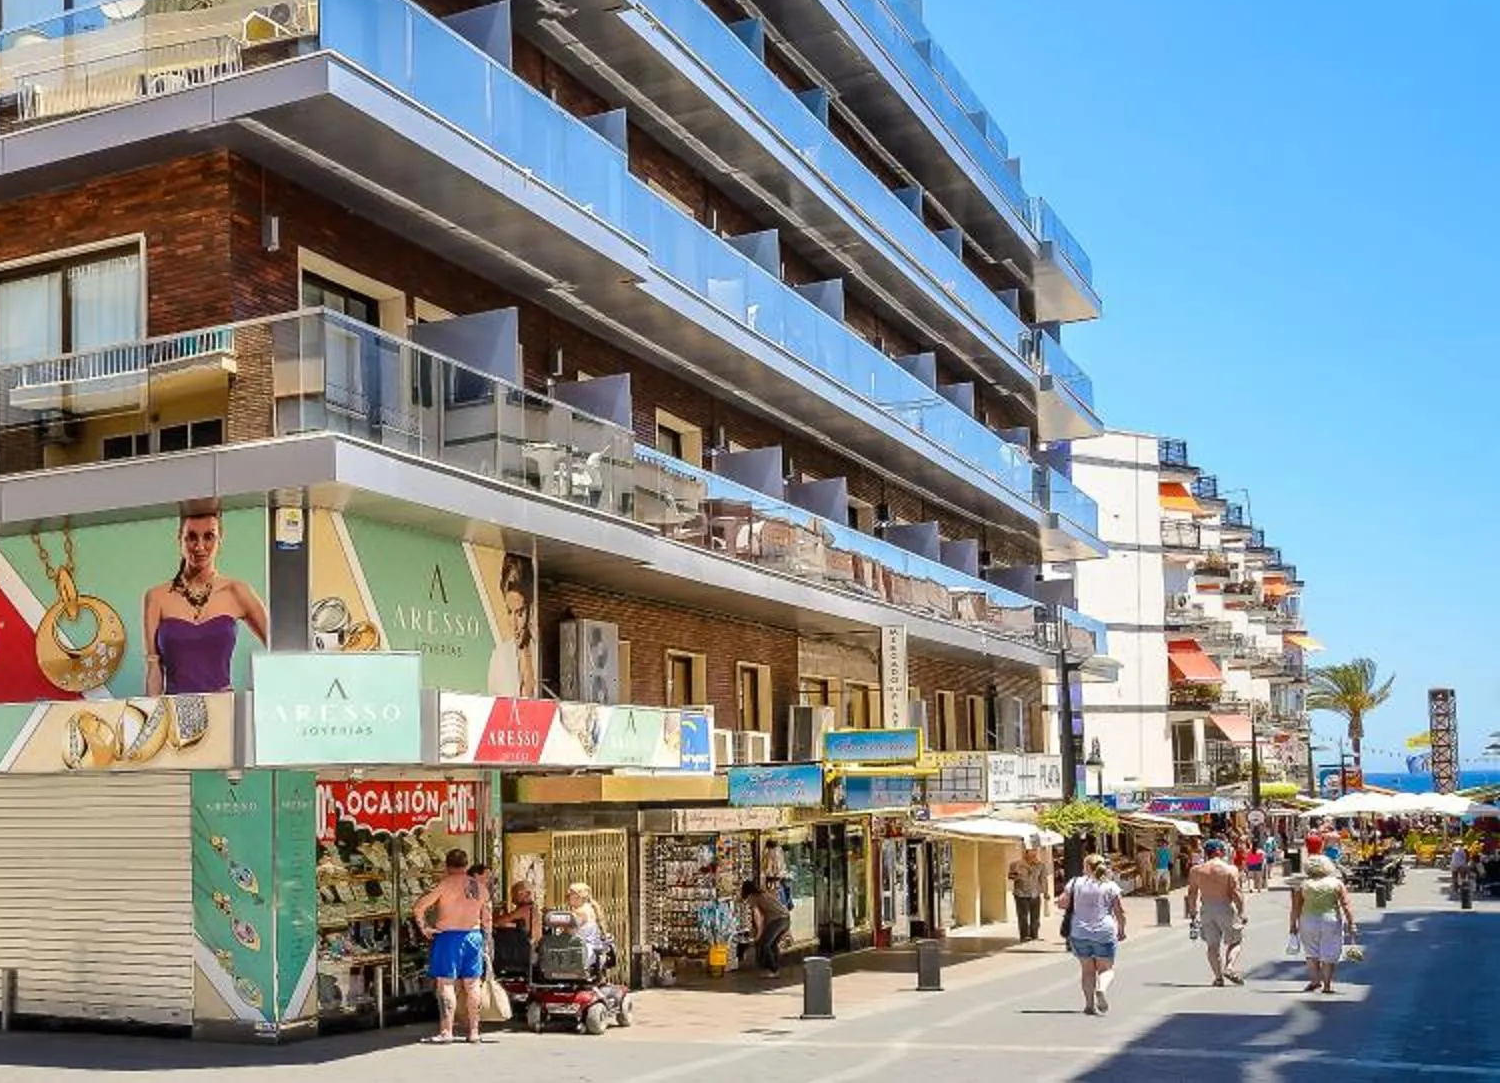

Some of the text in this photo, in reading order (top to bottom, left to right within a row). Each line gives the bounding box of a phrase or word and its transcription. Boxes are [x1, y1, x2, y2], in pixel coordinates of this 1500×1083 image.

[393, 604, 481, 638] ARESSO
[274, 703, 401, 723] ARESSO
[487, 730, 540, 746] ARESSO
[346, 783, 440, 815] OCASIÓN
